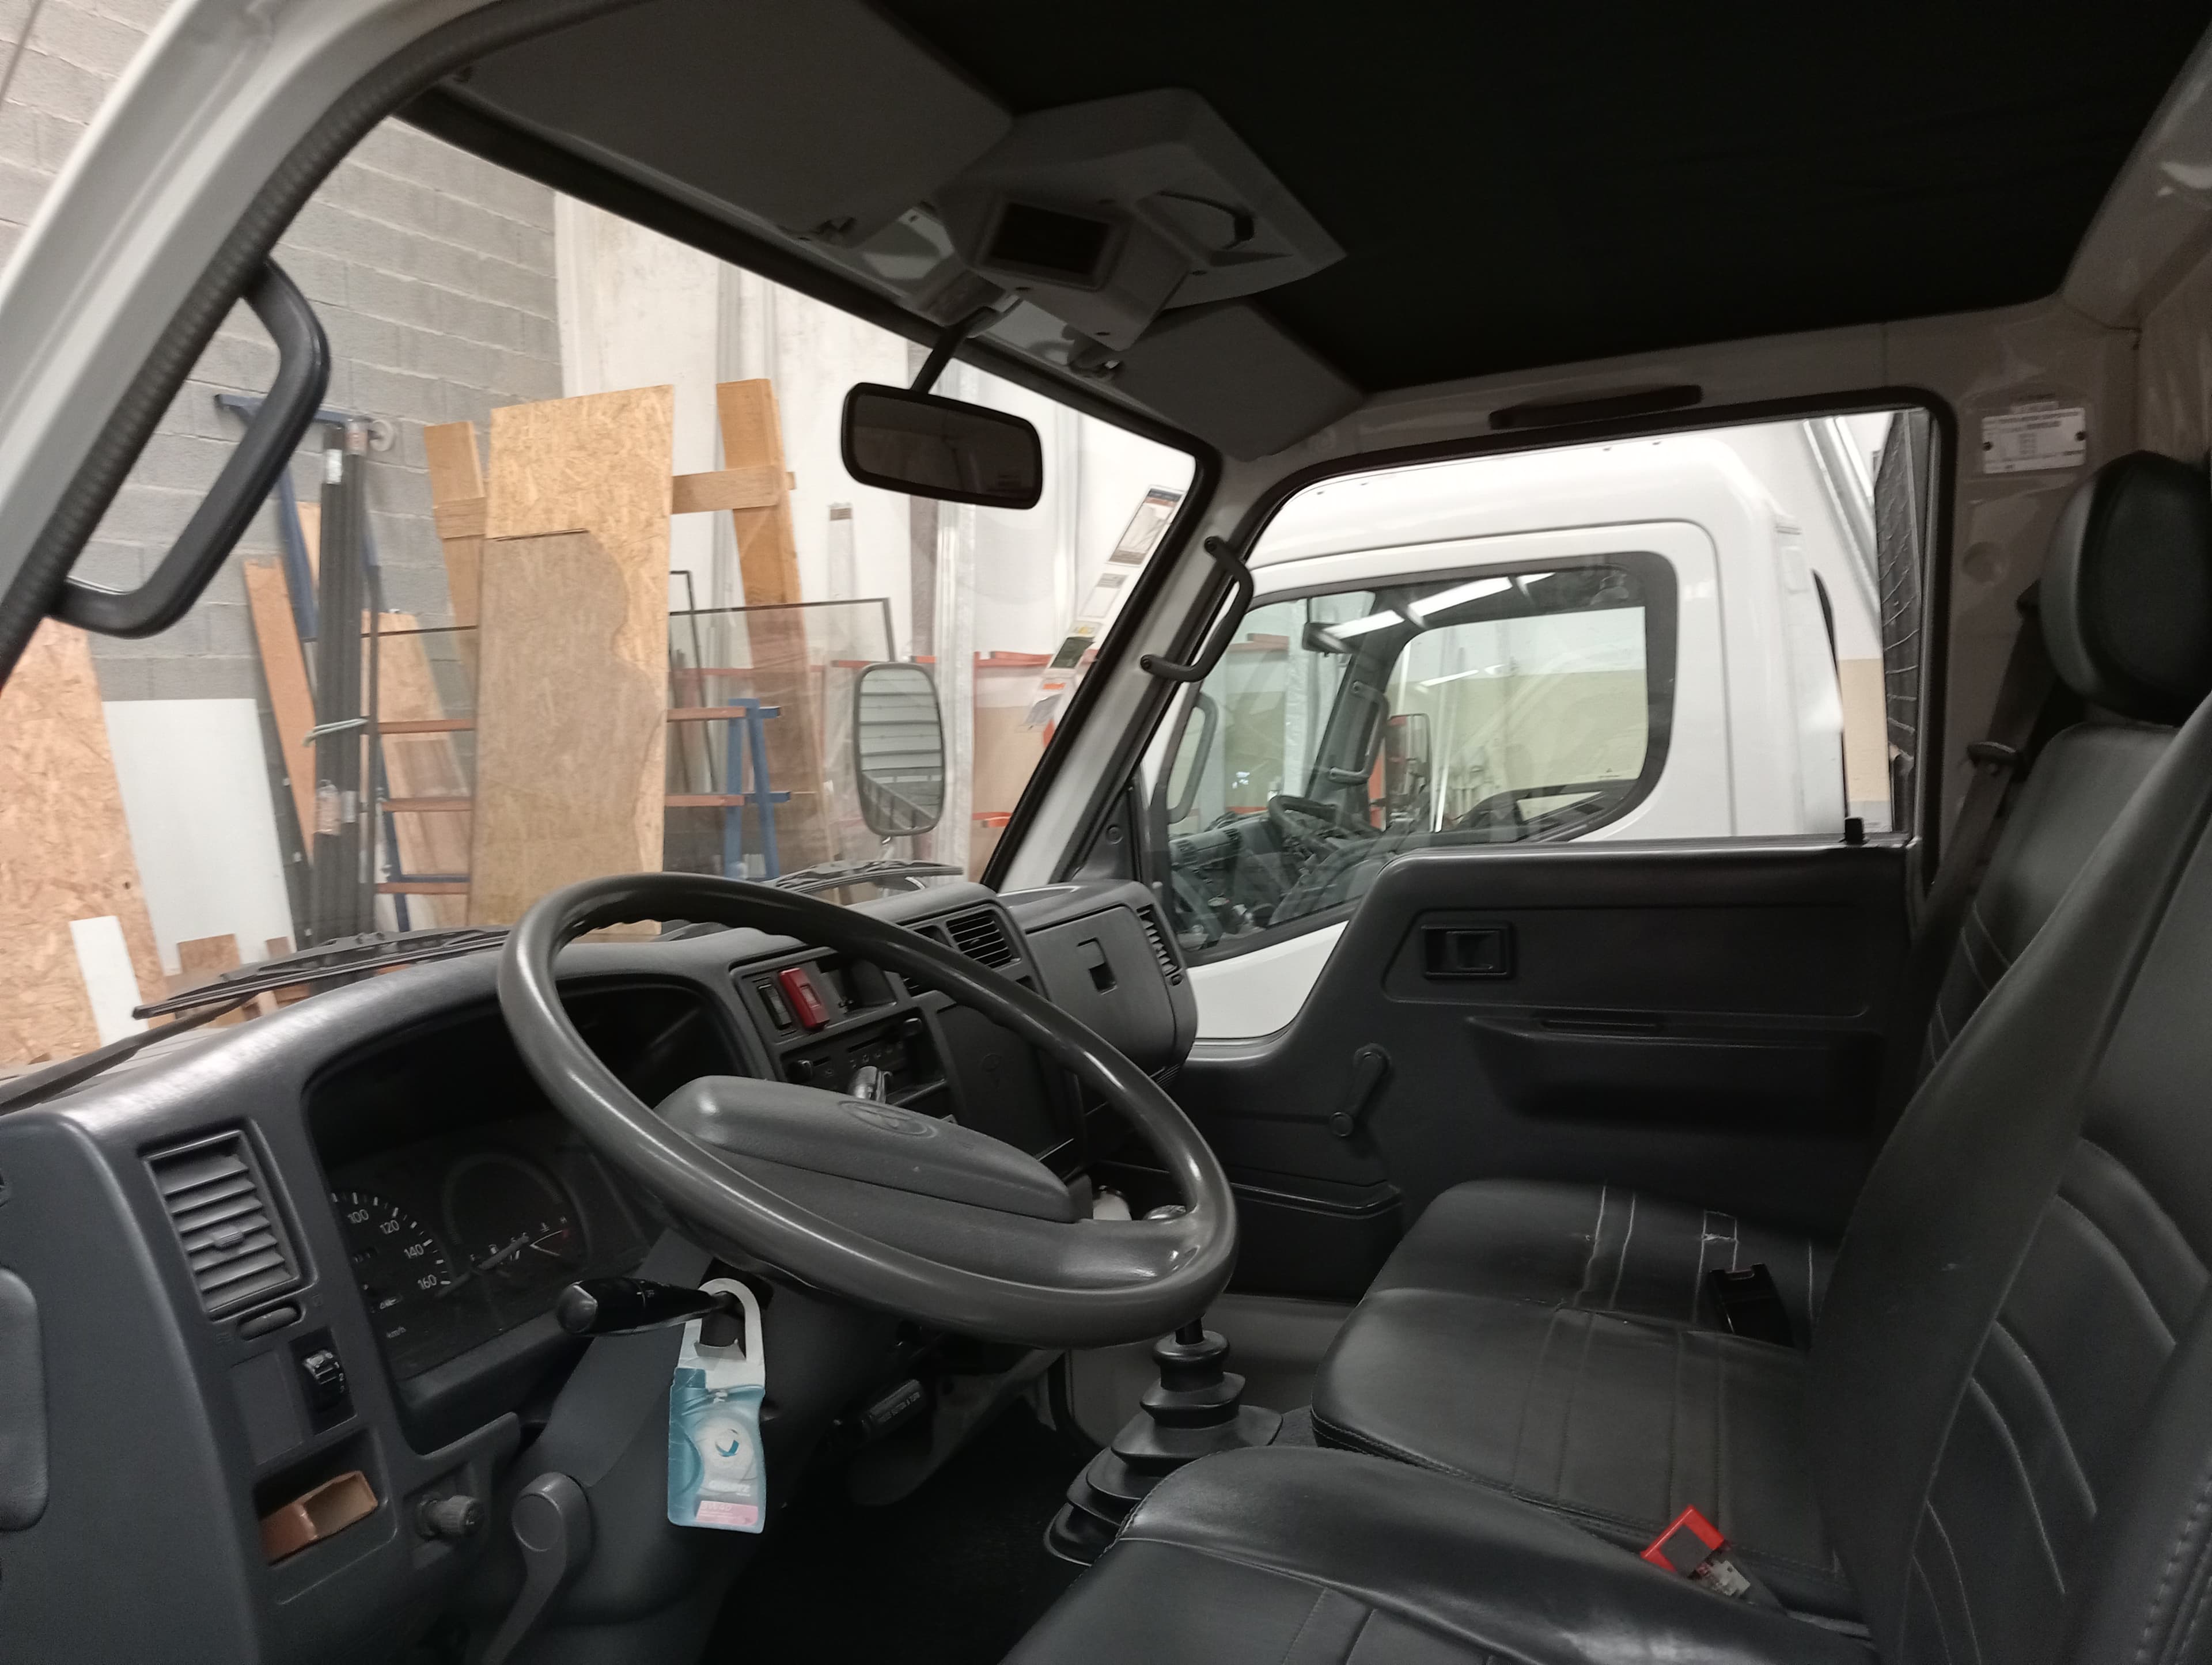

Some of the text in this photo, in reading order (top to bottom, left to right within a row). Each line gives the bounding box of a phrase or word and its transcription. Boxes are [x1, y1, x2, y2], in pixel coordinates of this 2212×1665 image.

[347, 1209, 369, 1224] 100
[380, 1220, 400, 1234] 120
[404, 1244, 424, 1260] 140
[418, 1274, 437, 1290] 160
[339, 1373, 344, 1382] 2
